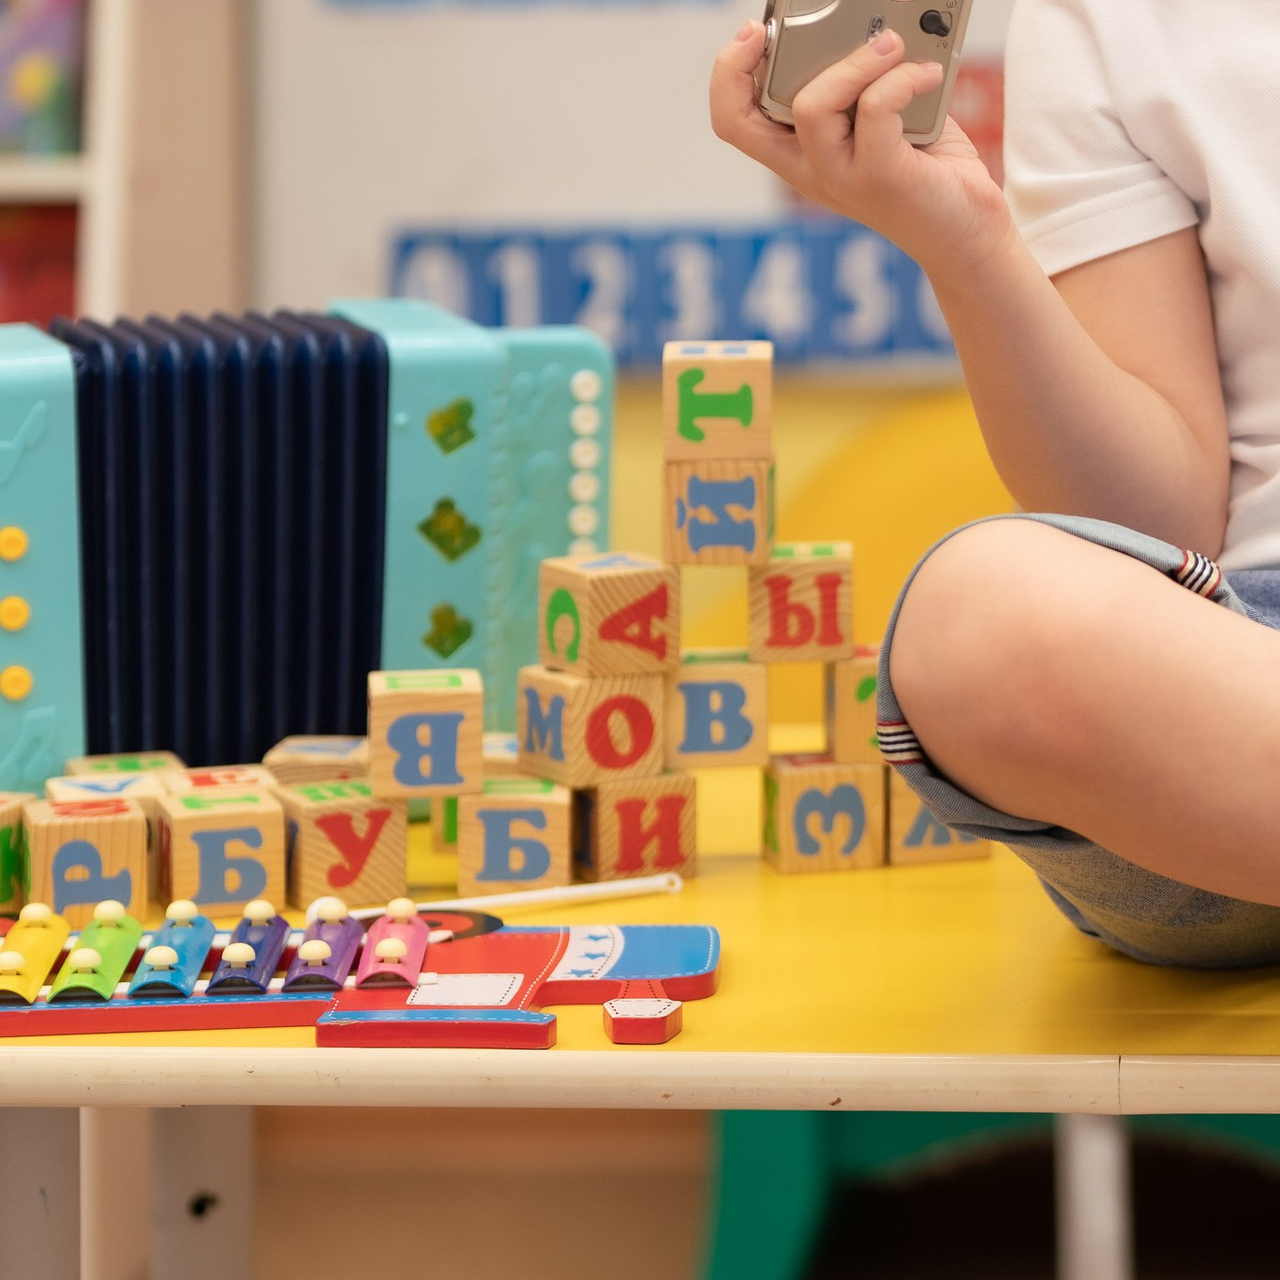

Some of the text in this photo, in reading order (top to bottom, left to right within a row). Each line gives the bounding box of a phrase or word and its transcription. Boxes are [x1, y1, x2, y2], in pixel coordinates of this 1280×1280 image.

[741, 237, 813, 343] 4
[677, 368, 754, 442] Т
[676, 475, 756, 553] Й
[545, 588, 581, 663] С
[599, 582, 669, 663] А
[764, 572, 845, 648] Ы
[525, 687, 566, 762] М
[584, 694, 656, 770] О
[678, 681, 753, 754] В
[190, 826, 267, 904] Б
[314, 808, 392, 889] У
[475, 809, 550, 881] Б
[614, 794, 687, 875] И
